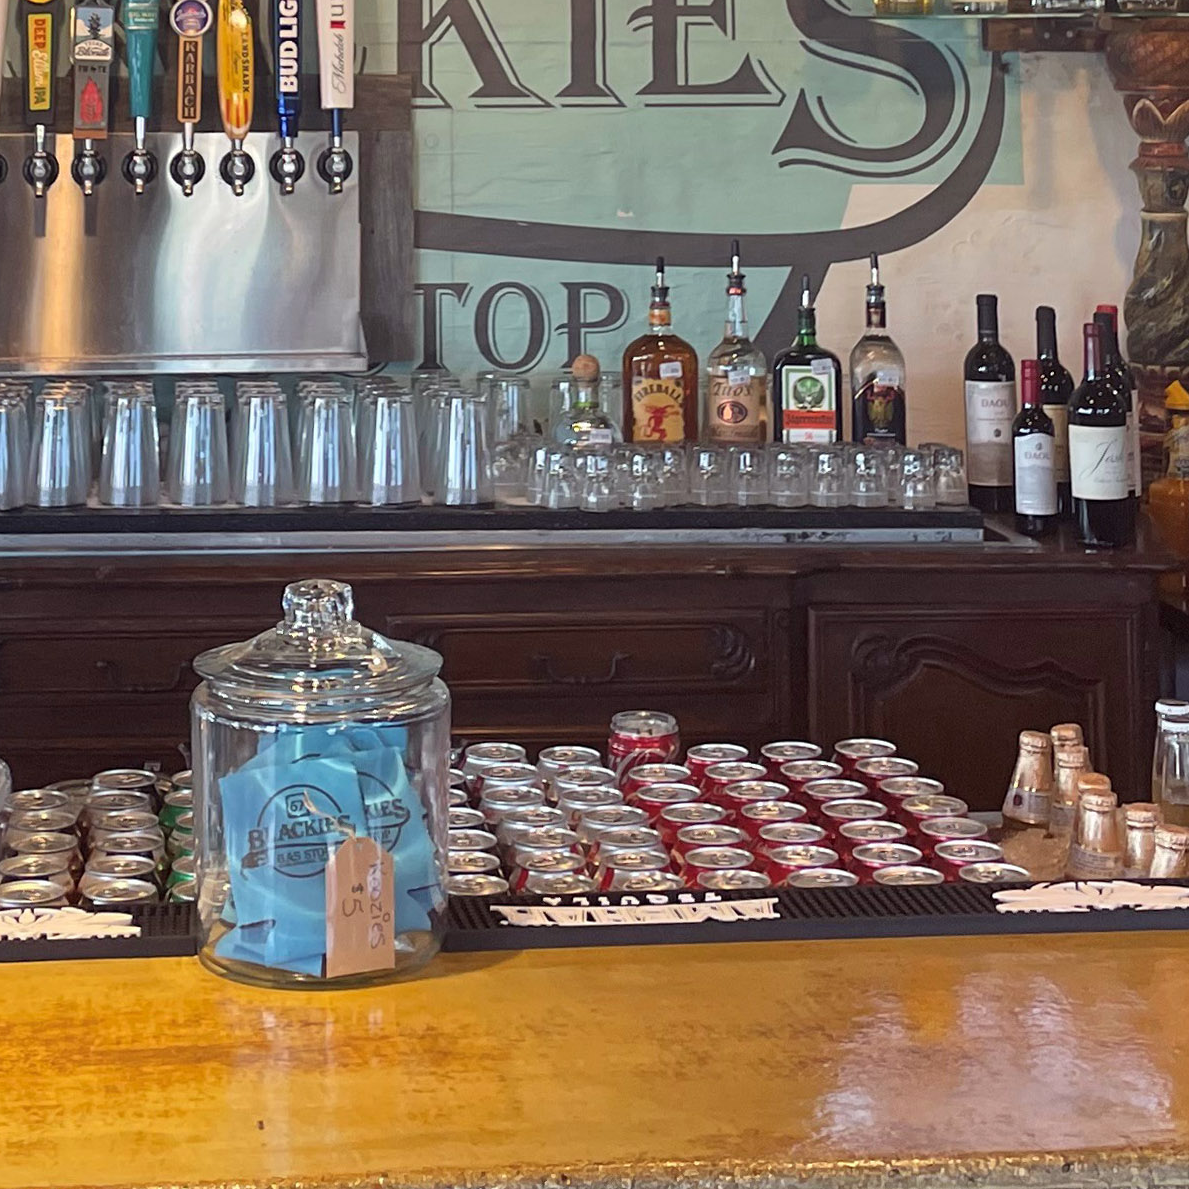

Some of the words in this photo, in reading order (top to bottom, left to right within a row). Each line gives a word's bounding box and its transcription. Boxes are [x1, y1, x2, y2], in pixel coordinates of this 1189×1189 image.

[34, 18, 46, 48] DEEP
[184, 42, 197, 117] KARBACH
[241, 31, 251, 93] LANDSHARK
[279, 40, 298, 93] BUD
[331, 33, 347, 94] Michelob
[34, 87, 46, 105] IPA
[347, 281, 630, 378] TOP
[633, 383, 684, 403] FIREBALL
[289, 800, 304, 812] 67
[542, 892, 723, 906] TEQUILA
